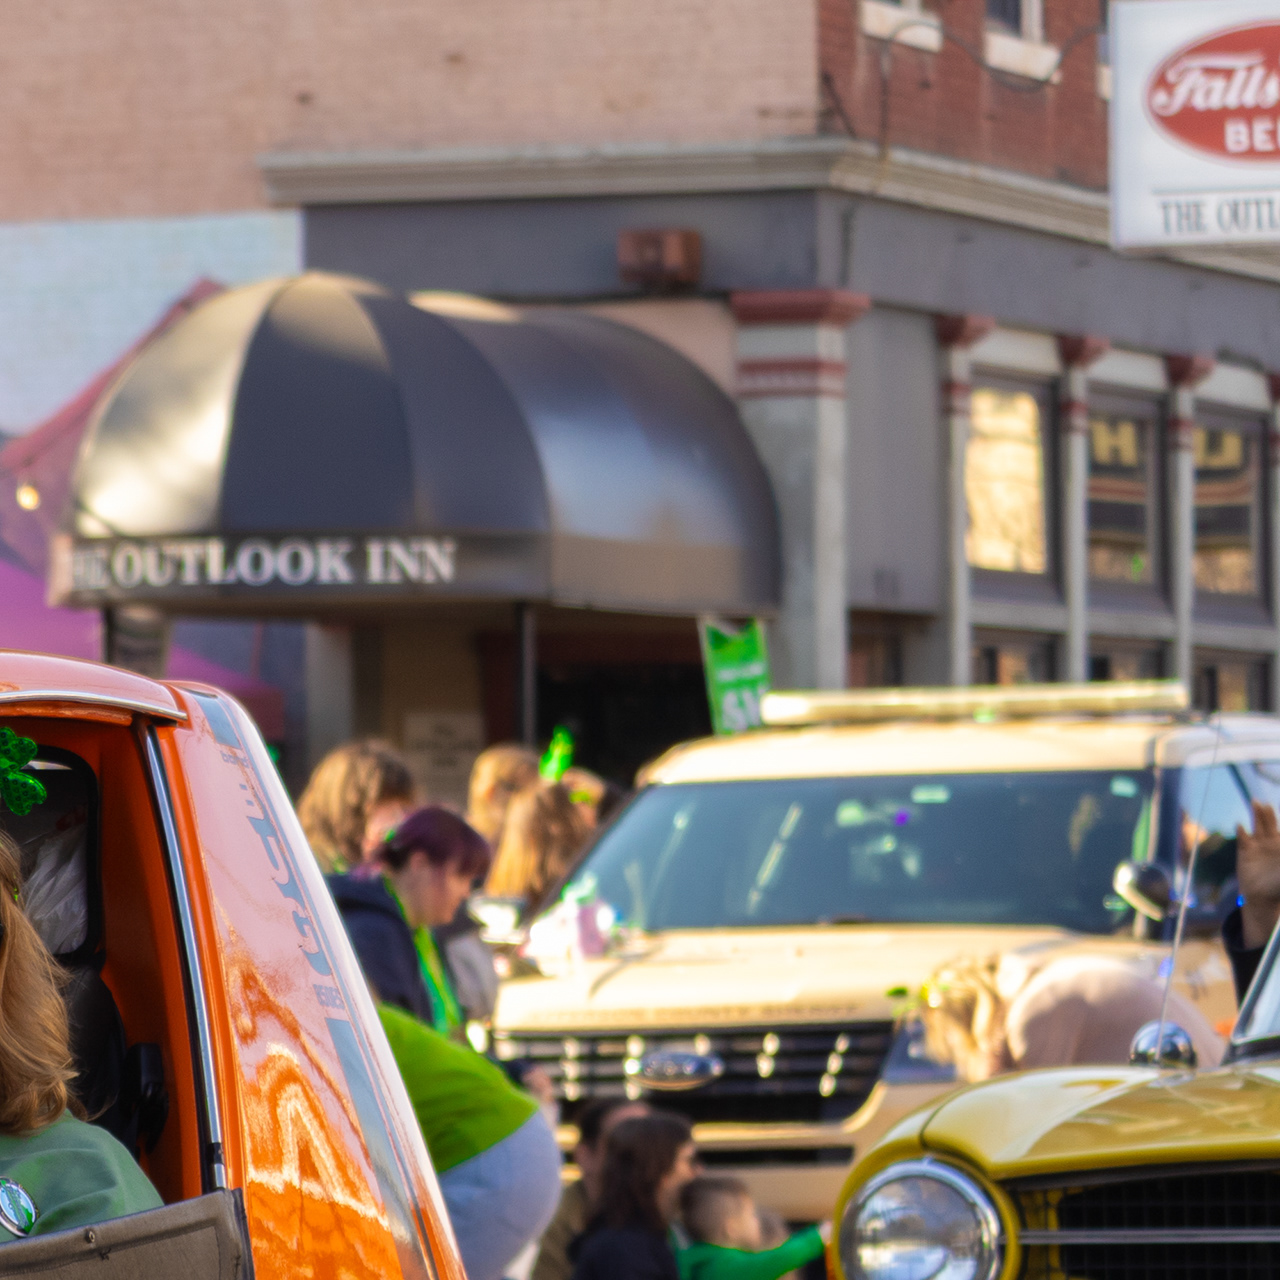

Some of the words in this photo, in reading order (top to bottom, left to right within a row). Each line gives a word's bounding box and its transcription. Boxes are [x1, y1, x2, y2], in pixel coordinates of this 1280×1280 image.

[1225, 117, 1280, 153] BE
[1160, 200, 1205, 234] THE
[112, 537, 353, 587] OUTLOOK
[365, 536, 456, 584] INN
